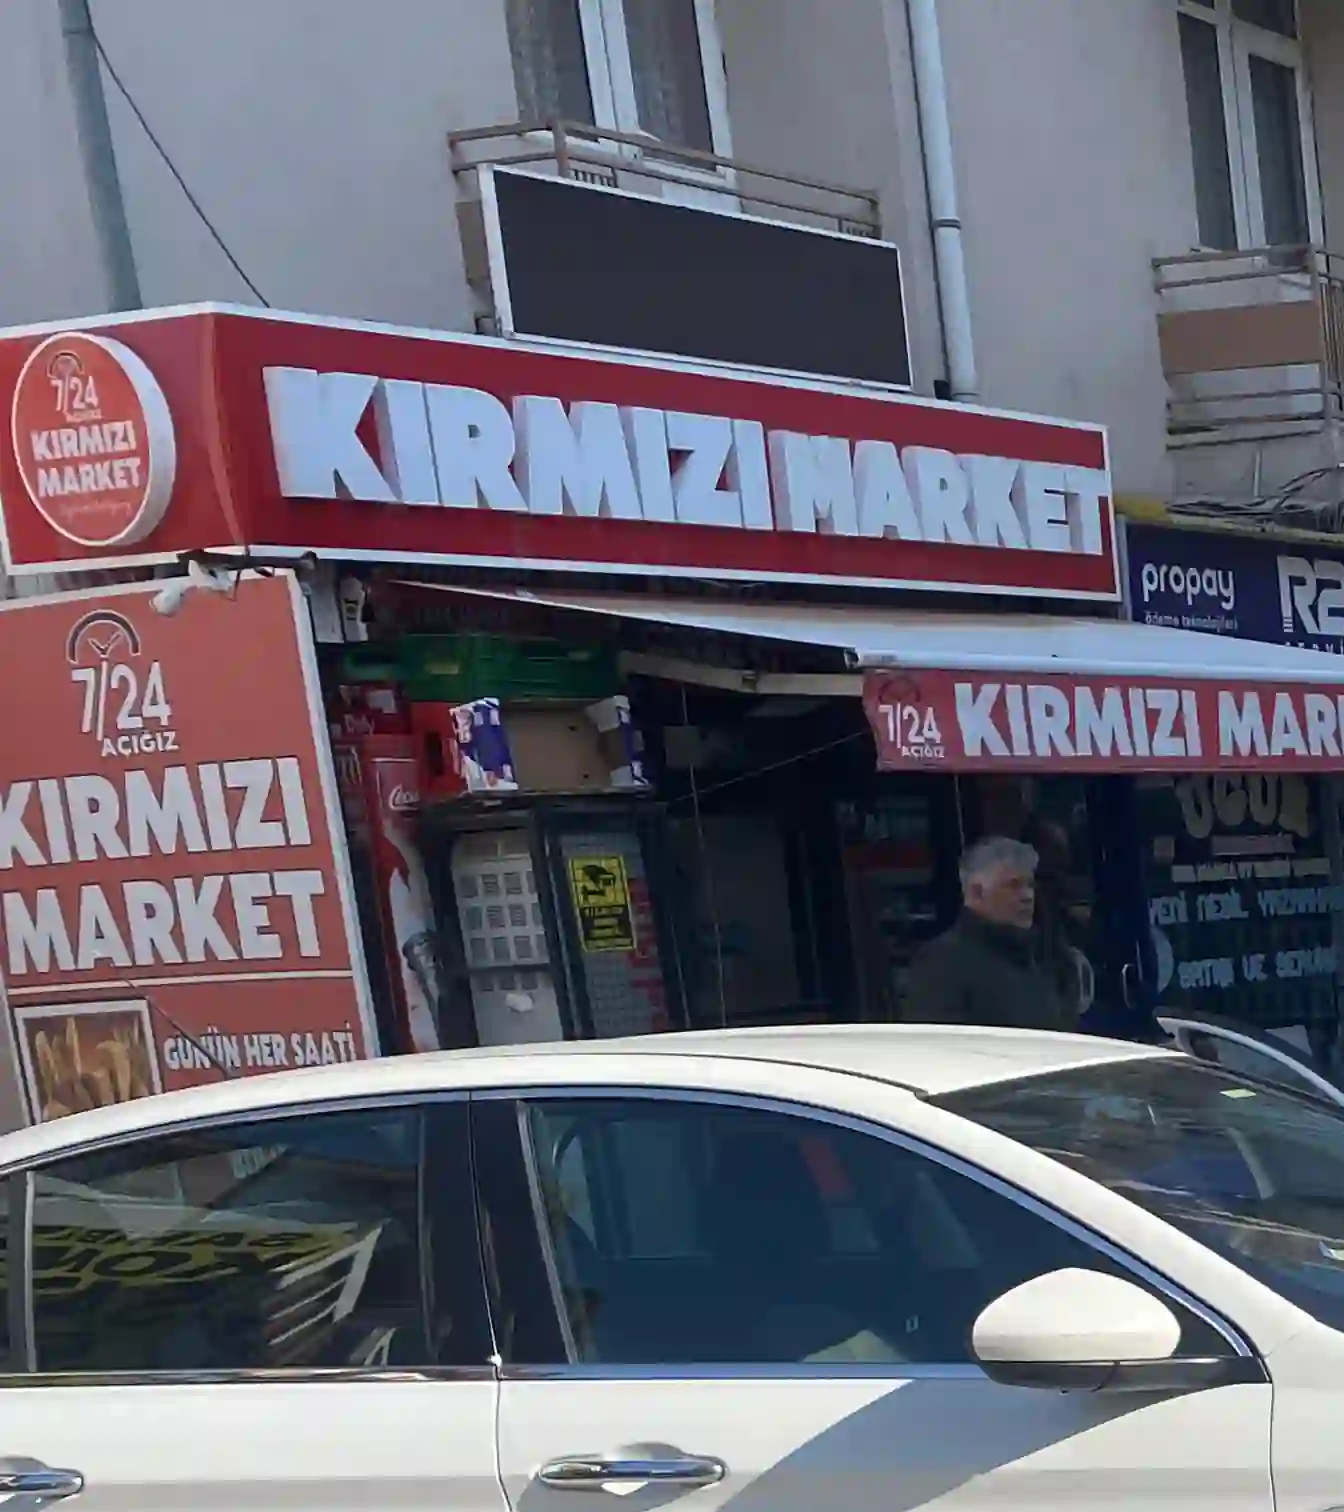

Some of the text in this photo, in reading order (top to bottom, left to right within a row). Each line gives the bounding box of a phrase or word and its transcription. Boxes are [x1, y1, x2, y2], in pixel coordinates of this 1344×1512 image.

[31, 420, 137, 460] KIRMIZI
[263, 366, 1111, 555] KIRMIZI MARKET
[37, 457, 141, 498] MARKET
[1142, 563, 1234, 610] propay
[71, 661, 172, 741] 7/24
[878, 702, 941, 748] 7/24
[954, 683, 1201, 756] KIRMIZI
[0, 758, 311, 869] KIRMIZI
[3, 870, 325, 975] MARKET
[244, 1034, 289, 1067] HER
[291, 1022, 357, 1066] SAATİ
